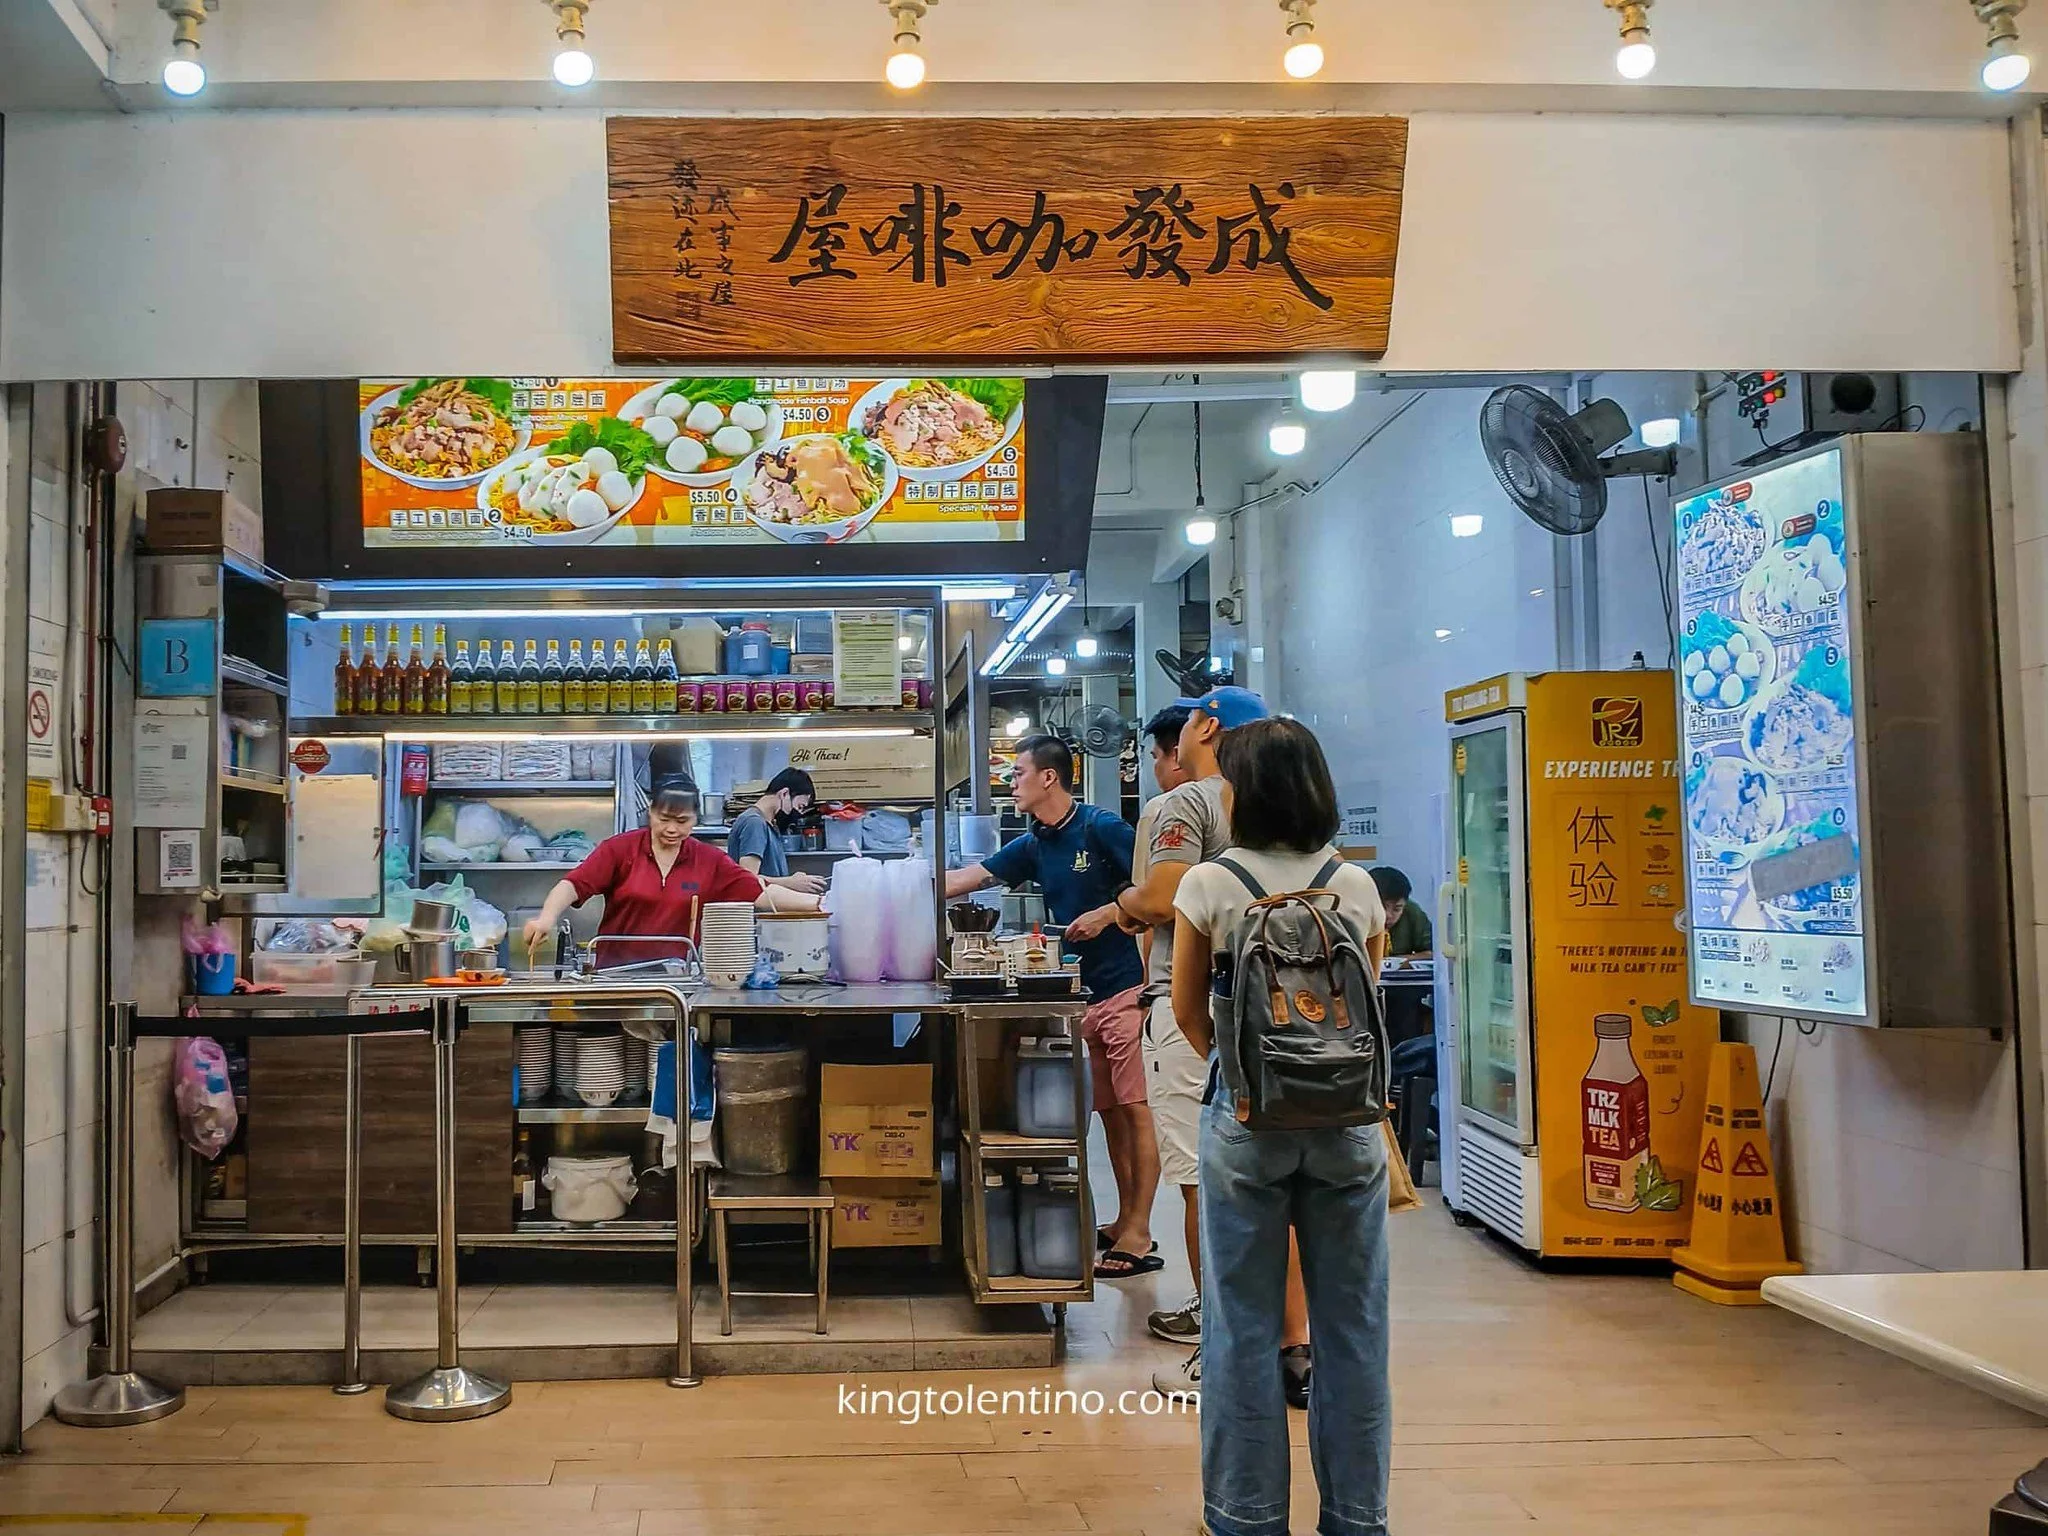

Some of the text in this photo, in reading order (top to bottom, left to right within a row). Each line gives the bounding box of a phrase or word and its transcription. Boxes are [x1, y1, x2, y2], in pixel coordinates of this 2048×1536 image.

[767, 182, 1334, 310] 成發咖啡屋
[828, 397, 849, 406] Soup
[783, 409, 812, 420] $4.50
[987, 464, 1016, 477] $4.50
[692, 491, 719, 503] $5.50
[504, 527, 532, 538] $4.50
[165, 639, 189, 674] B
[792, 749, 810, 762] Hi
[1544, 761, 1653, 778] EXPERIENCE
[1567, 805, 1619, 908] 体验
[1833, 887, 1854, 900] $5.50
[1608, 946, 1656, 957] NOTHING
[1570, 962, 1597, 973] MILK
[1601, 962, 1620, 973] TEA
[1624, 962, 1656, 973] CAN'T
[1587, 1088, 1620, 1109] TRZ
[828, 1133, 859, 1151] YK
[1589, 1126, 1620, 1147] TEA
[840, 1203, 871, 1221] YK
